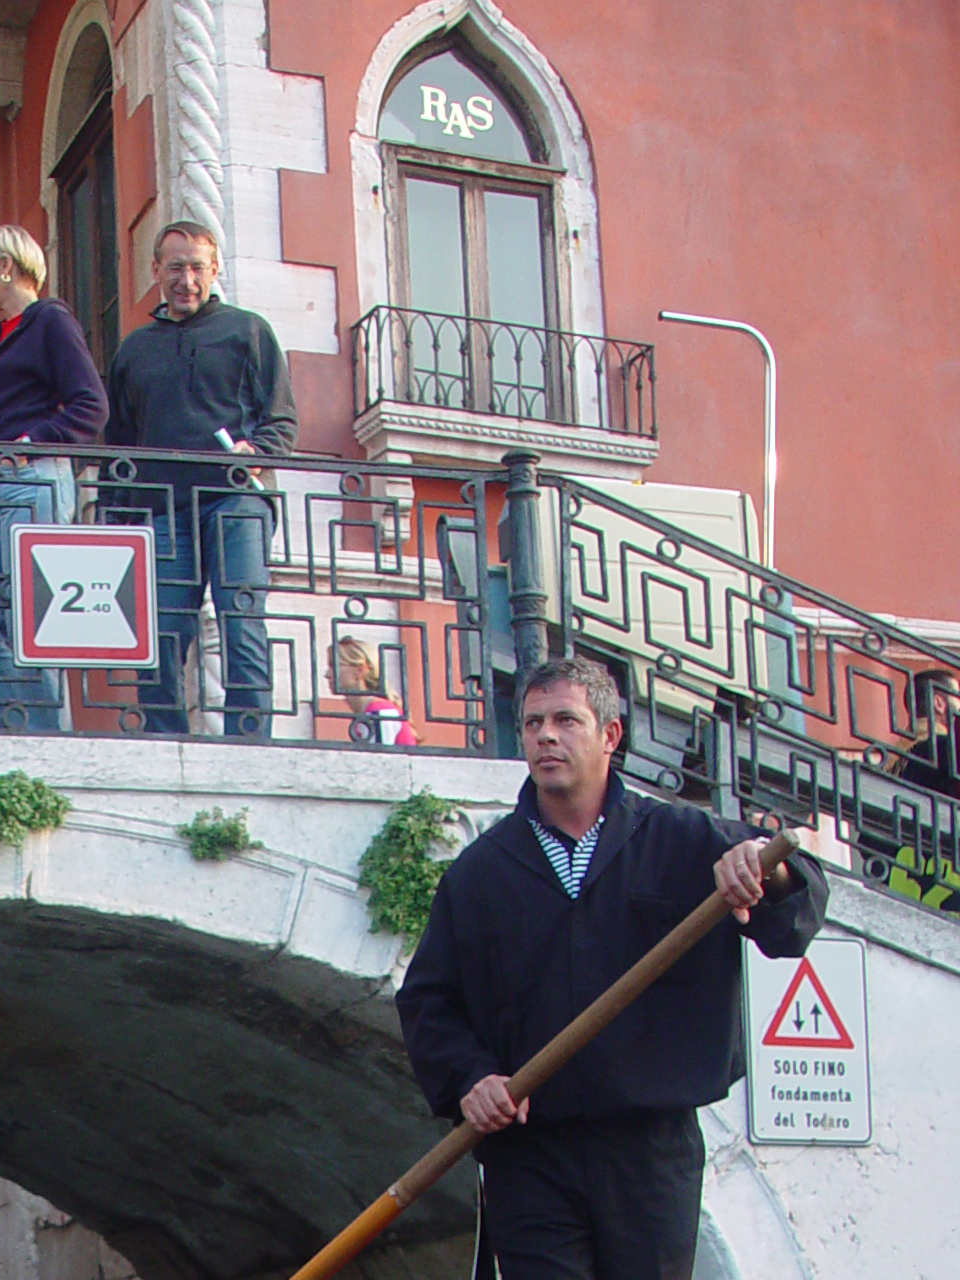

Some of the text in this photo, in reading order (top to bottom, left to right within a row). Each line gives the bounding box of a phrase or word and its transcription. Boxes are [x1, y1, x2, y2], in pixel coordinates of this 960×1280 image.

[420, 85, 494, 139] RAS
[773, 1059, 846, 1077] SOLO FINO
[771, 1084, 852, 1103] fondamenta
[773, 1111, 850, 1129] del Todaro
